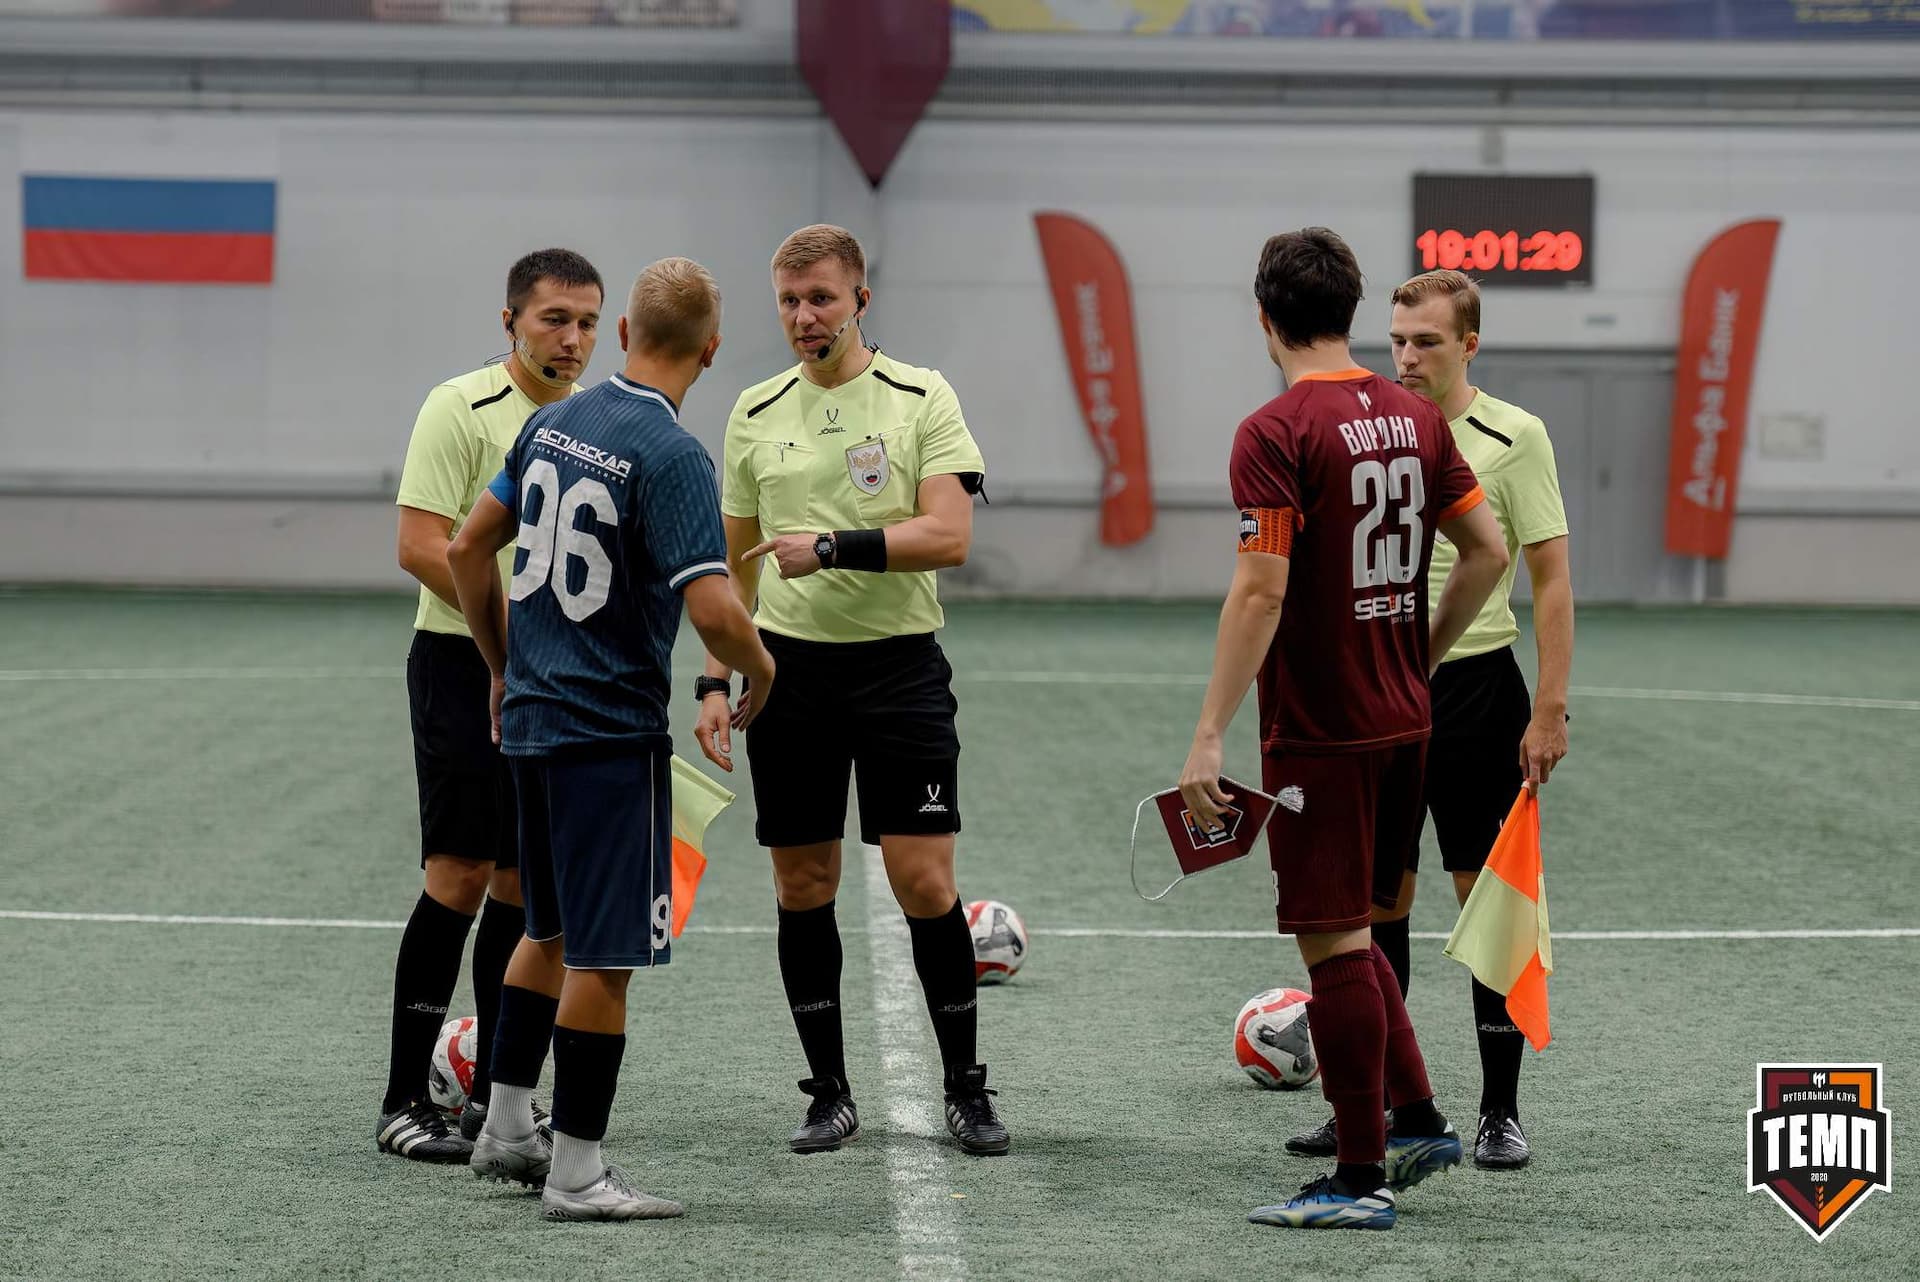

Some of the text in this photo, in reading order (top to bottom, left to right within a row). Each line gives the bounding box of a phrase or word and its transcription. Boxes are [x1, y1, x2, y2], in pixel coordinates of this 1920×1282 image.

[1416, 229, 1582, 271] 19:01:29
[1338, 415, 1418, 456] ВОРОНА
[509, 458, 618, 622] 96
[1351, 456, 1425, 589] 23
[918, 803, 948, 812] JÖGEL
